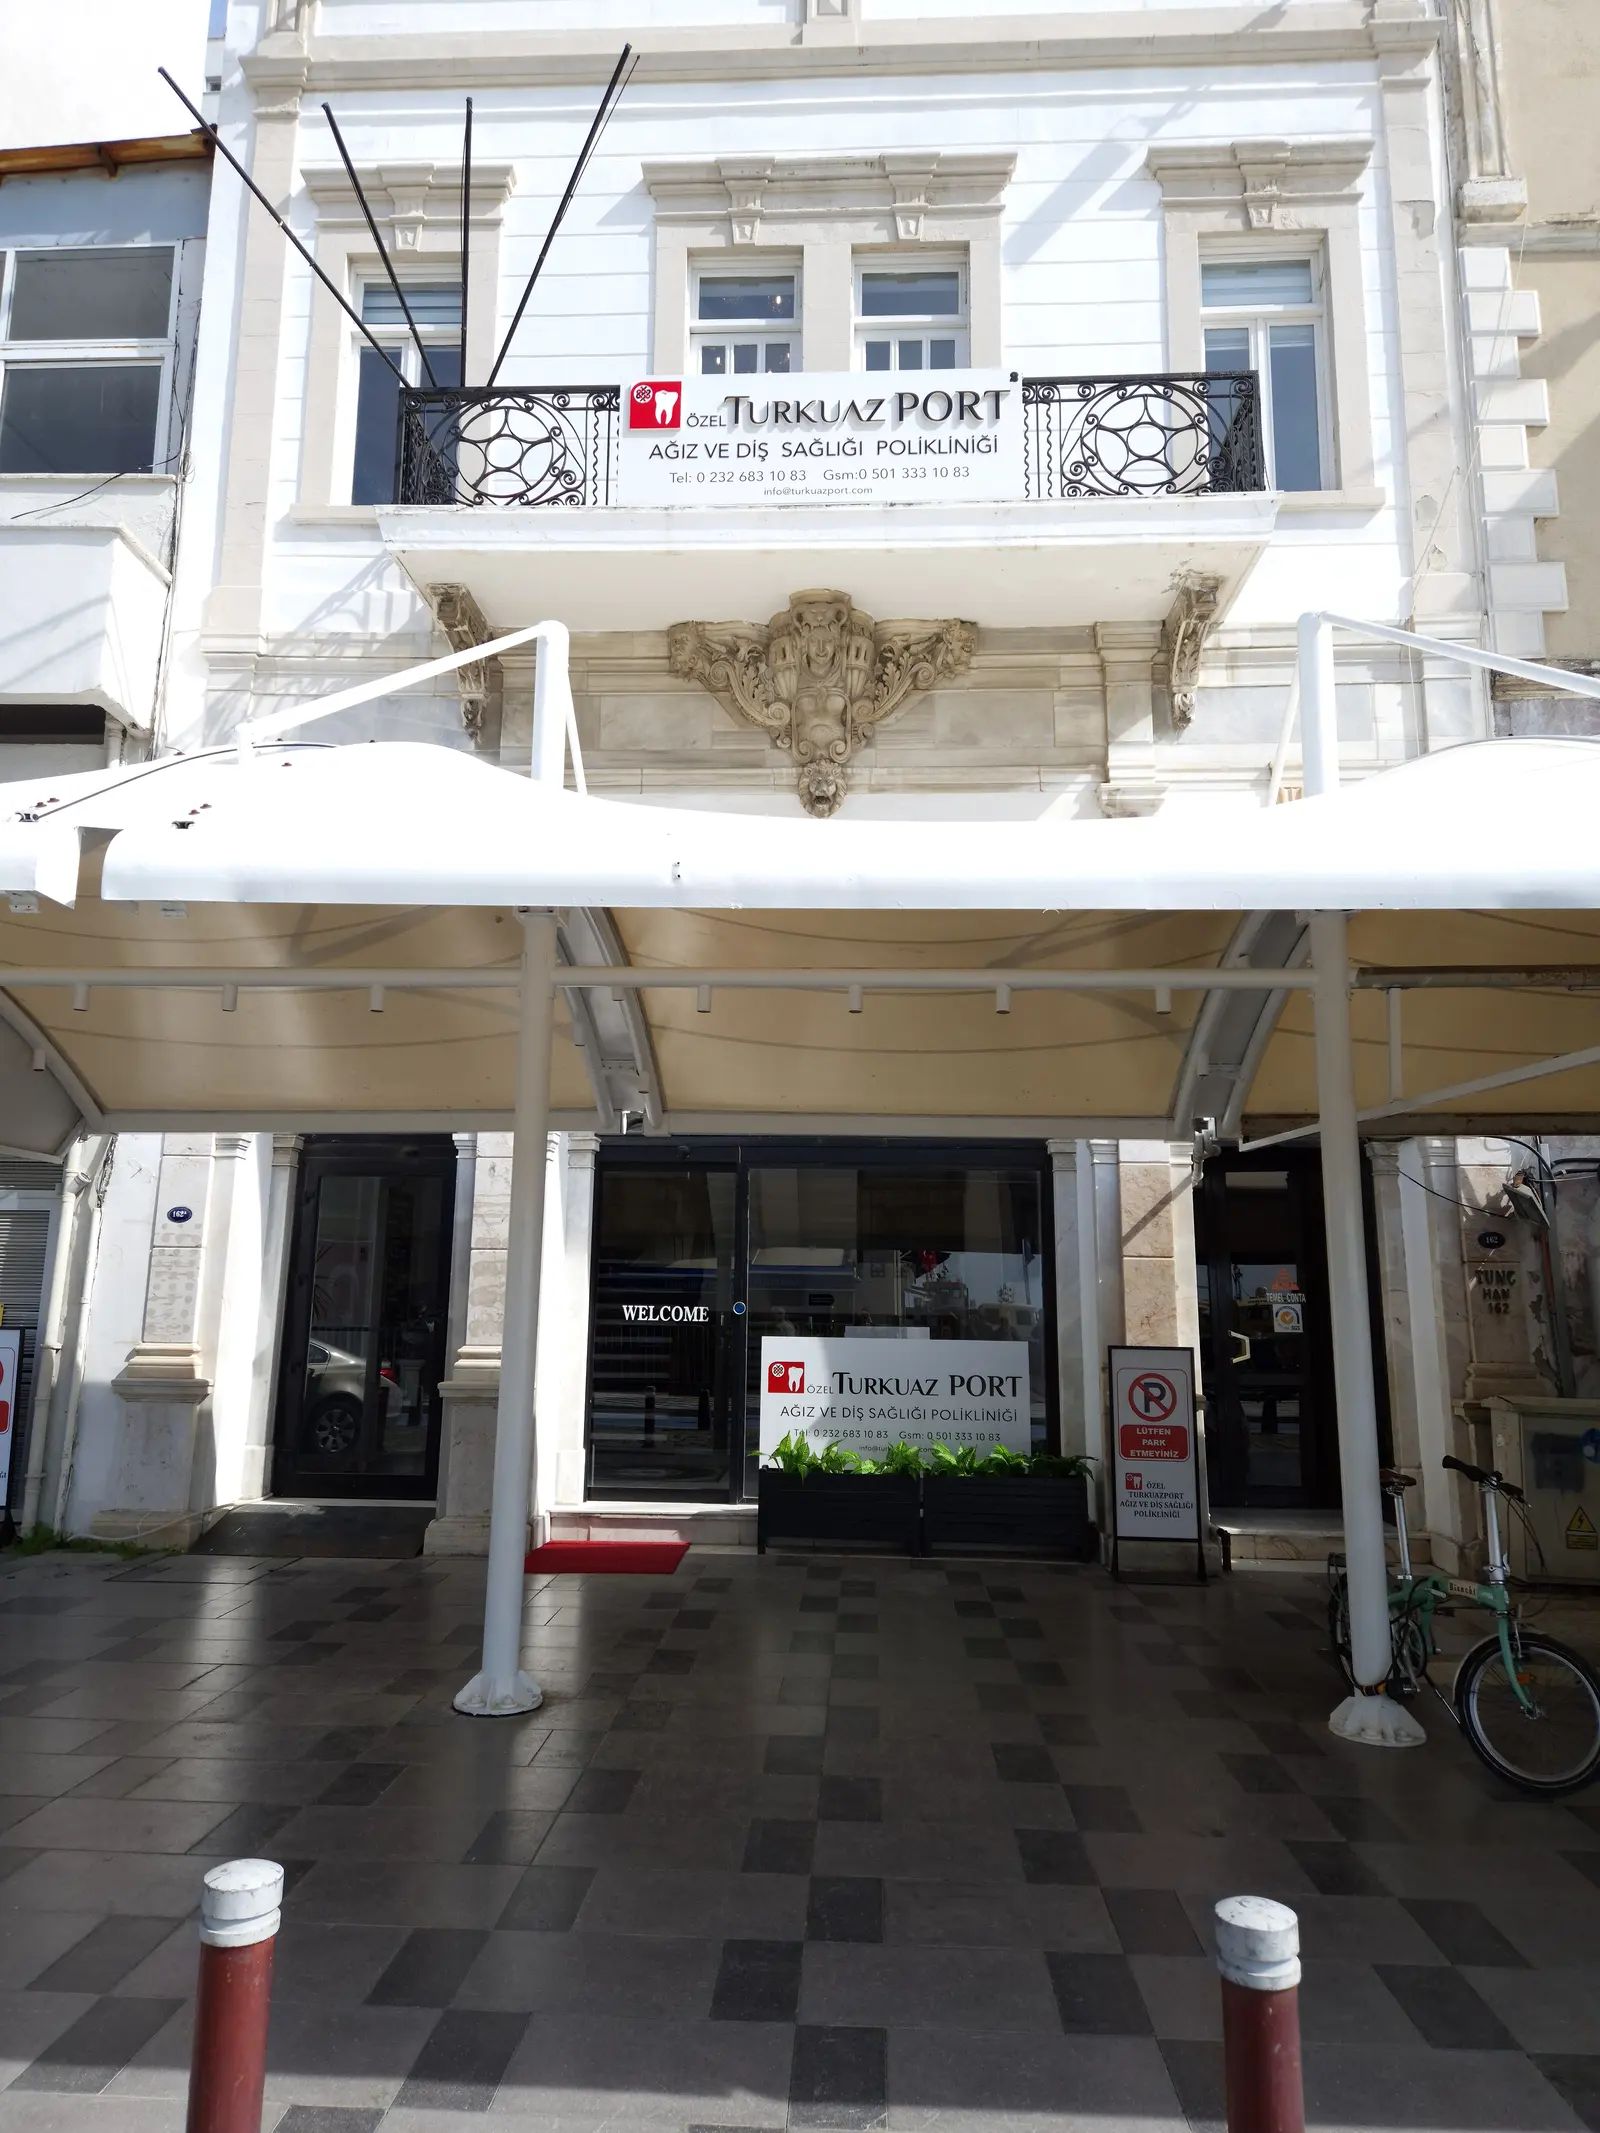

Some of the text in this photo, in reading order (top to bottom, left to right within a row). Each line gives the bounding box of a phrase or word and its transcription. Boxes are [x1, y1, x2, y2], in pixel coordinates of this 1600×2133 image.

[686, 413, 726, 428] ÖZEL
[897, 390, 1011, 422] PORT
[649, 435, 998, 462] AĞIZ VE DİŞ SAĞLIĞI POLİKLİNİĞİ
[670, 472, 692, 484] Tel:
[696, 471, 705, 483] 0
[709, 471, 735, 483] 232
[739, 471, 765, 483] 683
[770, 470, 786, 482] 10
[789, 470, 807, 481] 83
[871, 468, 897, 480] 501
[901, 467, 927, 479] 333
[932, 467, 948, 479] 10
[952, 466, 970, 478] 83
[763, 486, 873, 497] info@turkuazport.com
[1486, 1236, 1498, 1244] 162
[1266, 1292, 1306, 1303] TEMEL CONTA
[1483, 1288, 1510, 1300] HAN
[622, 1305, 709, 1322] WELCOME
[1488, 1302, 1510, 1314] 162
[807, 1371, 1022, 1397] ÖZEL TURKUAZ PORT
[780, 1404, 1017, 1422] AĞIZ VE DİŞ SAĞLIĞI POLİKLİNİĞİ
[813, 1429, 819, 1437] 0
[822, 1429, 840, 1438] 232
[843, 1430, 860, 1438] 683
[864, 1430, 874, 1438] 10
[876, 1430, 888, 1439] 83
[899, 1431, 924, 1440] Gsm:
[927, 1431, 933, 1440] 0
[935, 1432, 952, 1441] 501
[954, 1432, 973, 1441] 333
[976, 1433, 986, 1441] 10
[988, 1433, 1000, 1442] 83
[1136, 1427, 1171, 1435] LÜTFEN
[1130, 1449, 1179, 1458] ETMEYİNİZ
[1128, 1491, 1184, 1499] TURKUAZPORT
[1120, 1499, 1137, 1508] AĞIZ
[1150, 1500, 1163, 1509] DİŞ
[1164, 1500, 1193, 1509] SAĞLIĞI
[1134, 1509, 1180, 1518] POLİKLİNİĞİ
